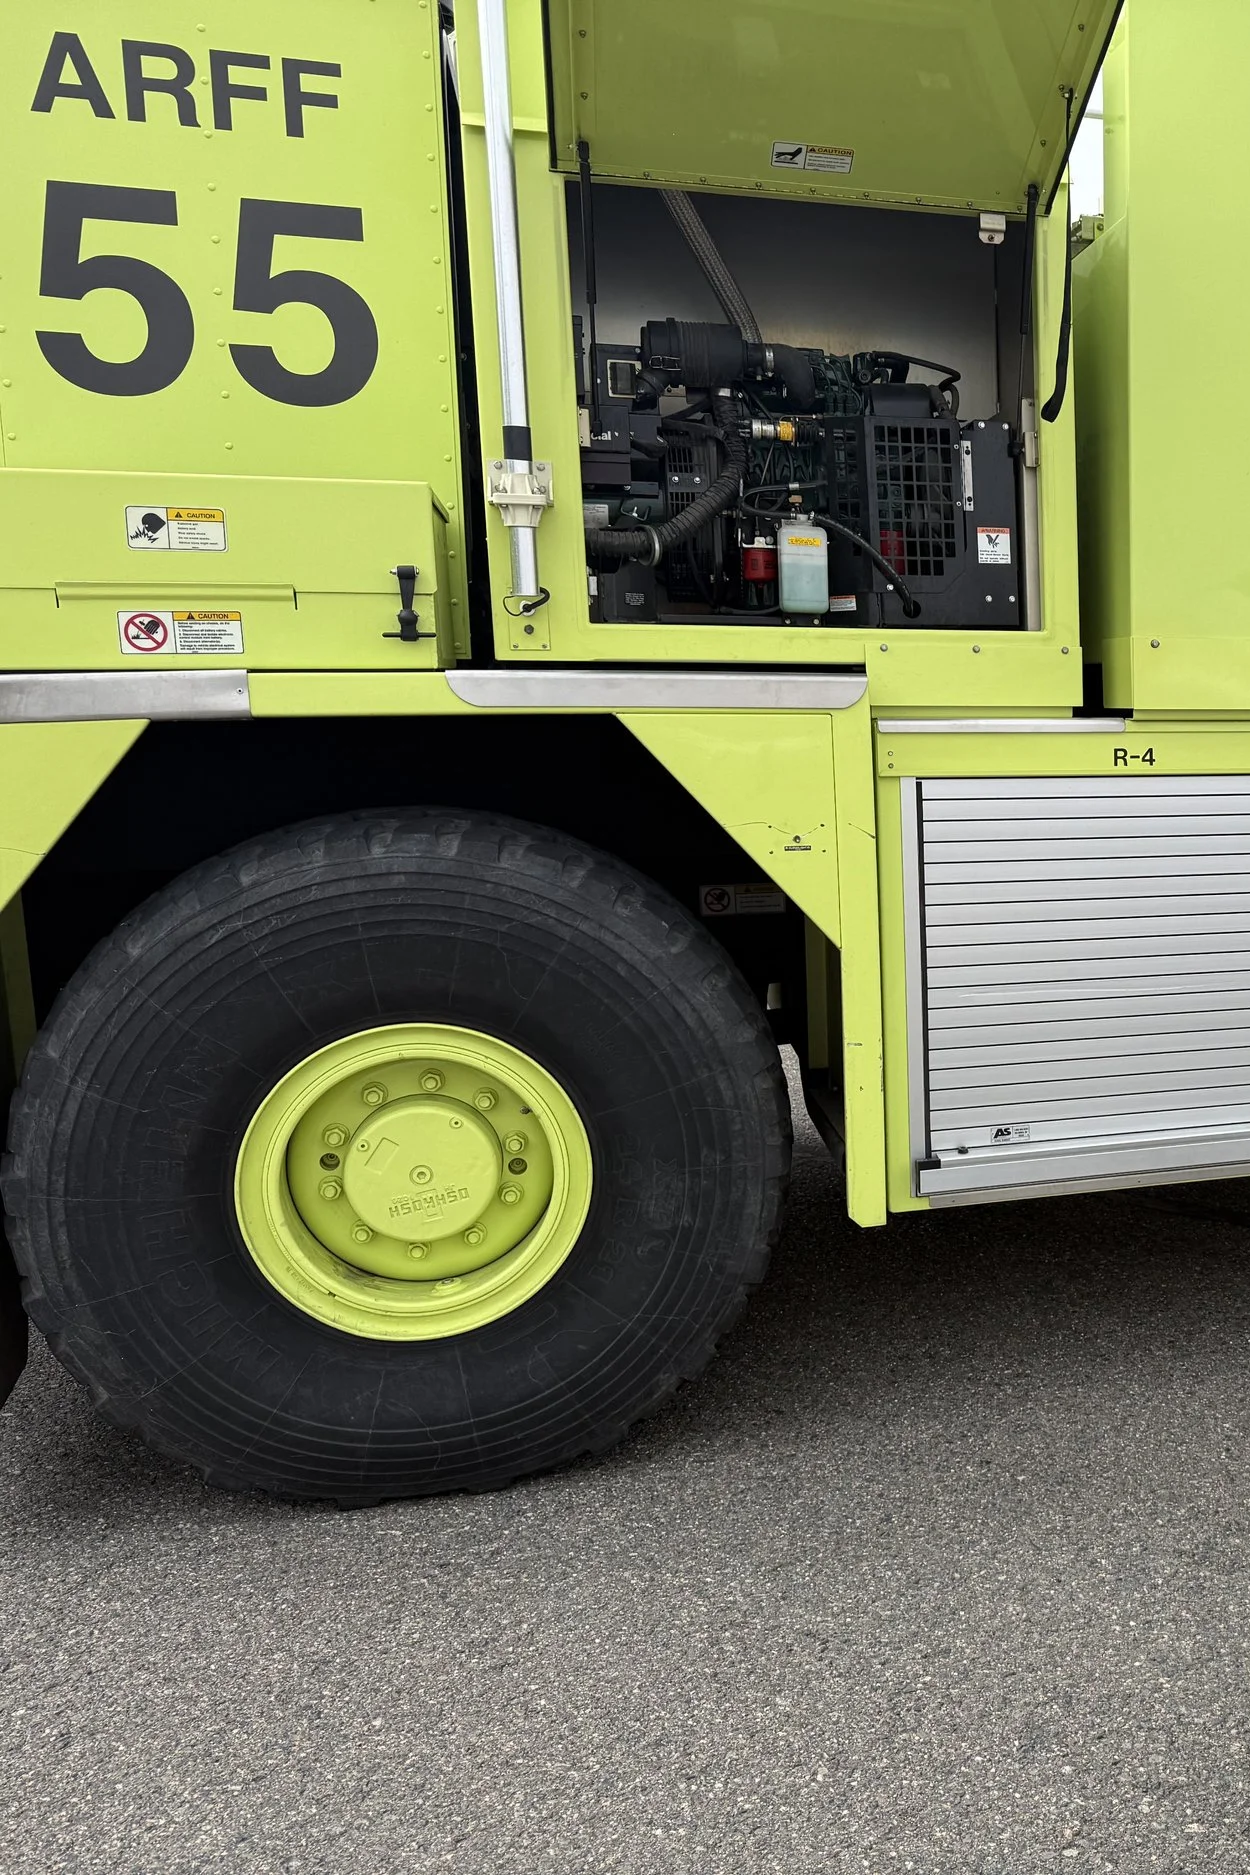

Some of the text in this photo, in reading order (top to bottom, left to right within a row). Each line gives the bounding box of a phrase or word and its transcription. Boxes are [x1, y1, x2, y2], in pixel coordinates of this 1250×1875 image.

[31, 31, 342, 139] ARFF
[818, 147, 852, 156] CAUTION
[35, 180, 379, 407] 55
[1113, 747, 1156, 767] R-4
[387, 1187, 471, 1219] OSHKOSH
